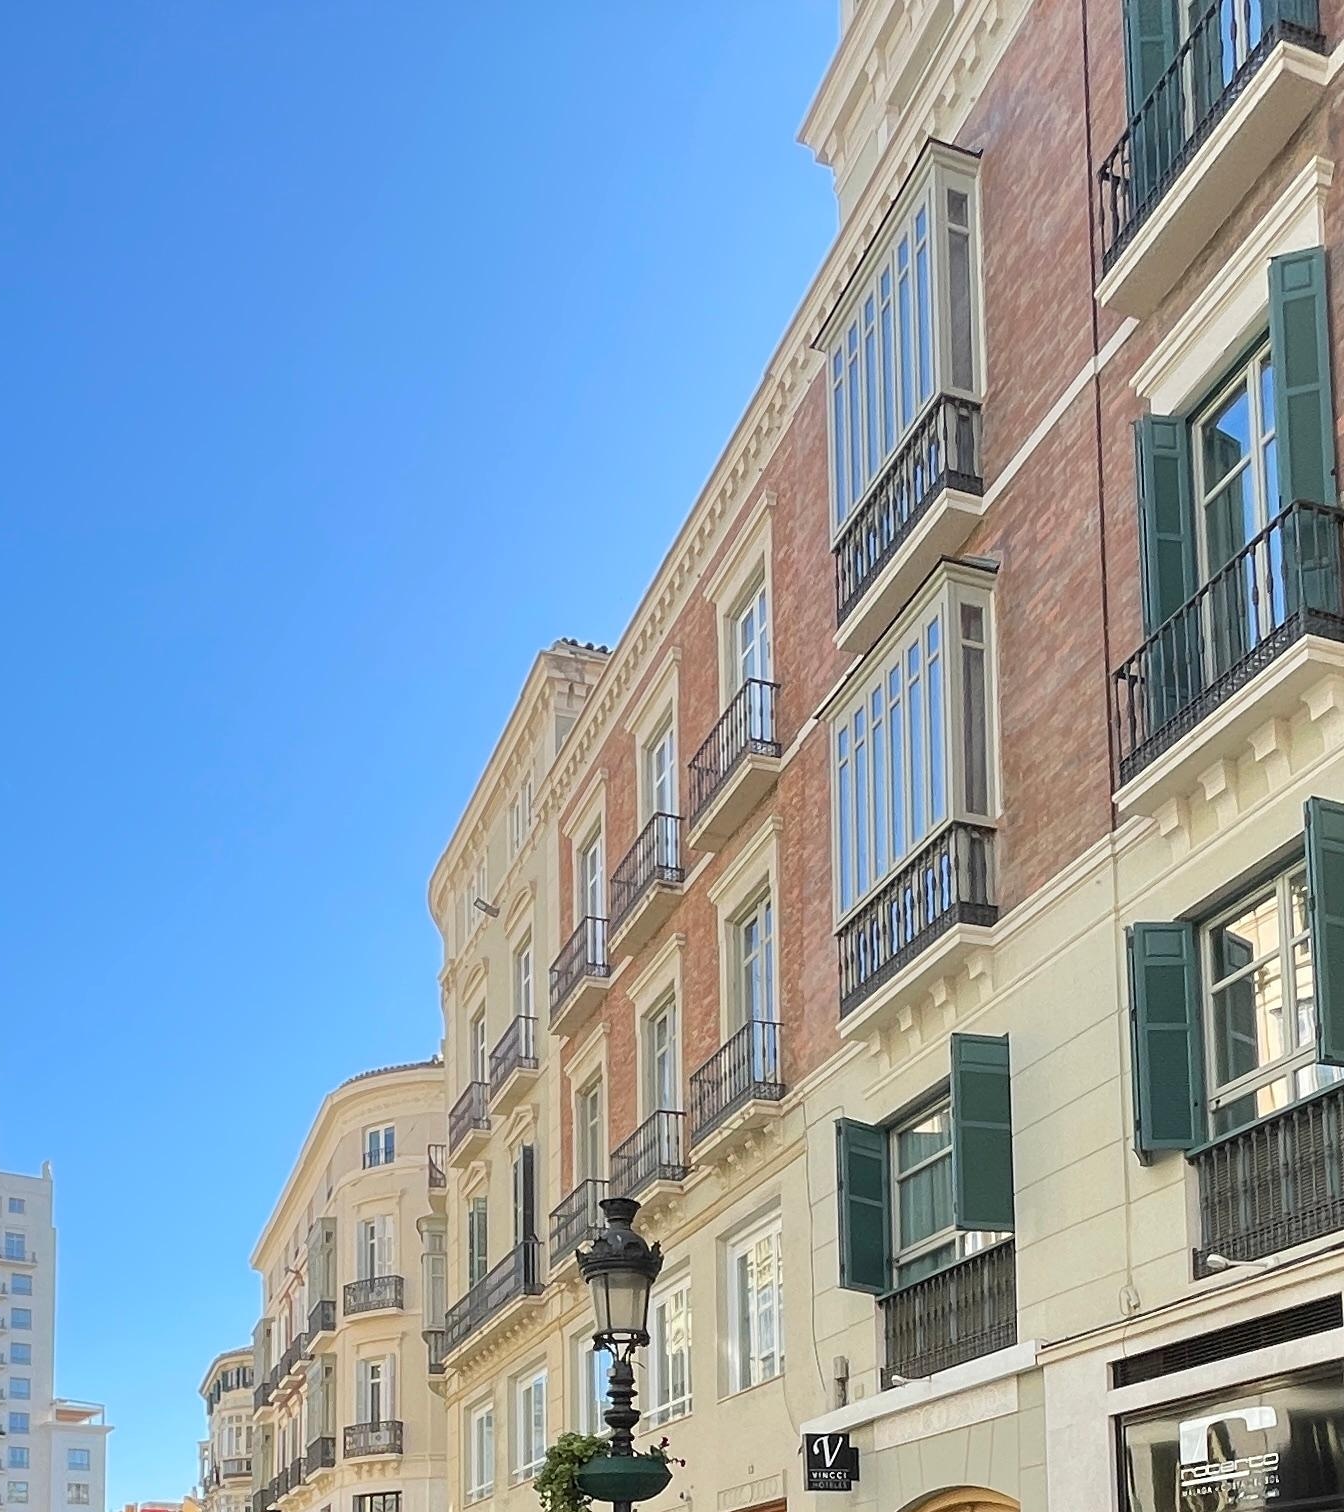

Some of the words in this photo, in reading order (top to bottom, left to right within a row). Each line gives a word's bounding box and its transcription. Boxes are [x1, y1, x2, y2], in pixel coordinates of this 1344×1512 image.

[813, 1435, 844, 1468] V
[812, 1471, 847, 1480] VINCCI
[1180, 1452, 1279, 1481] roberto
